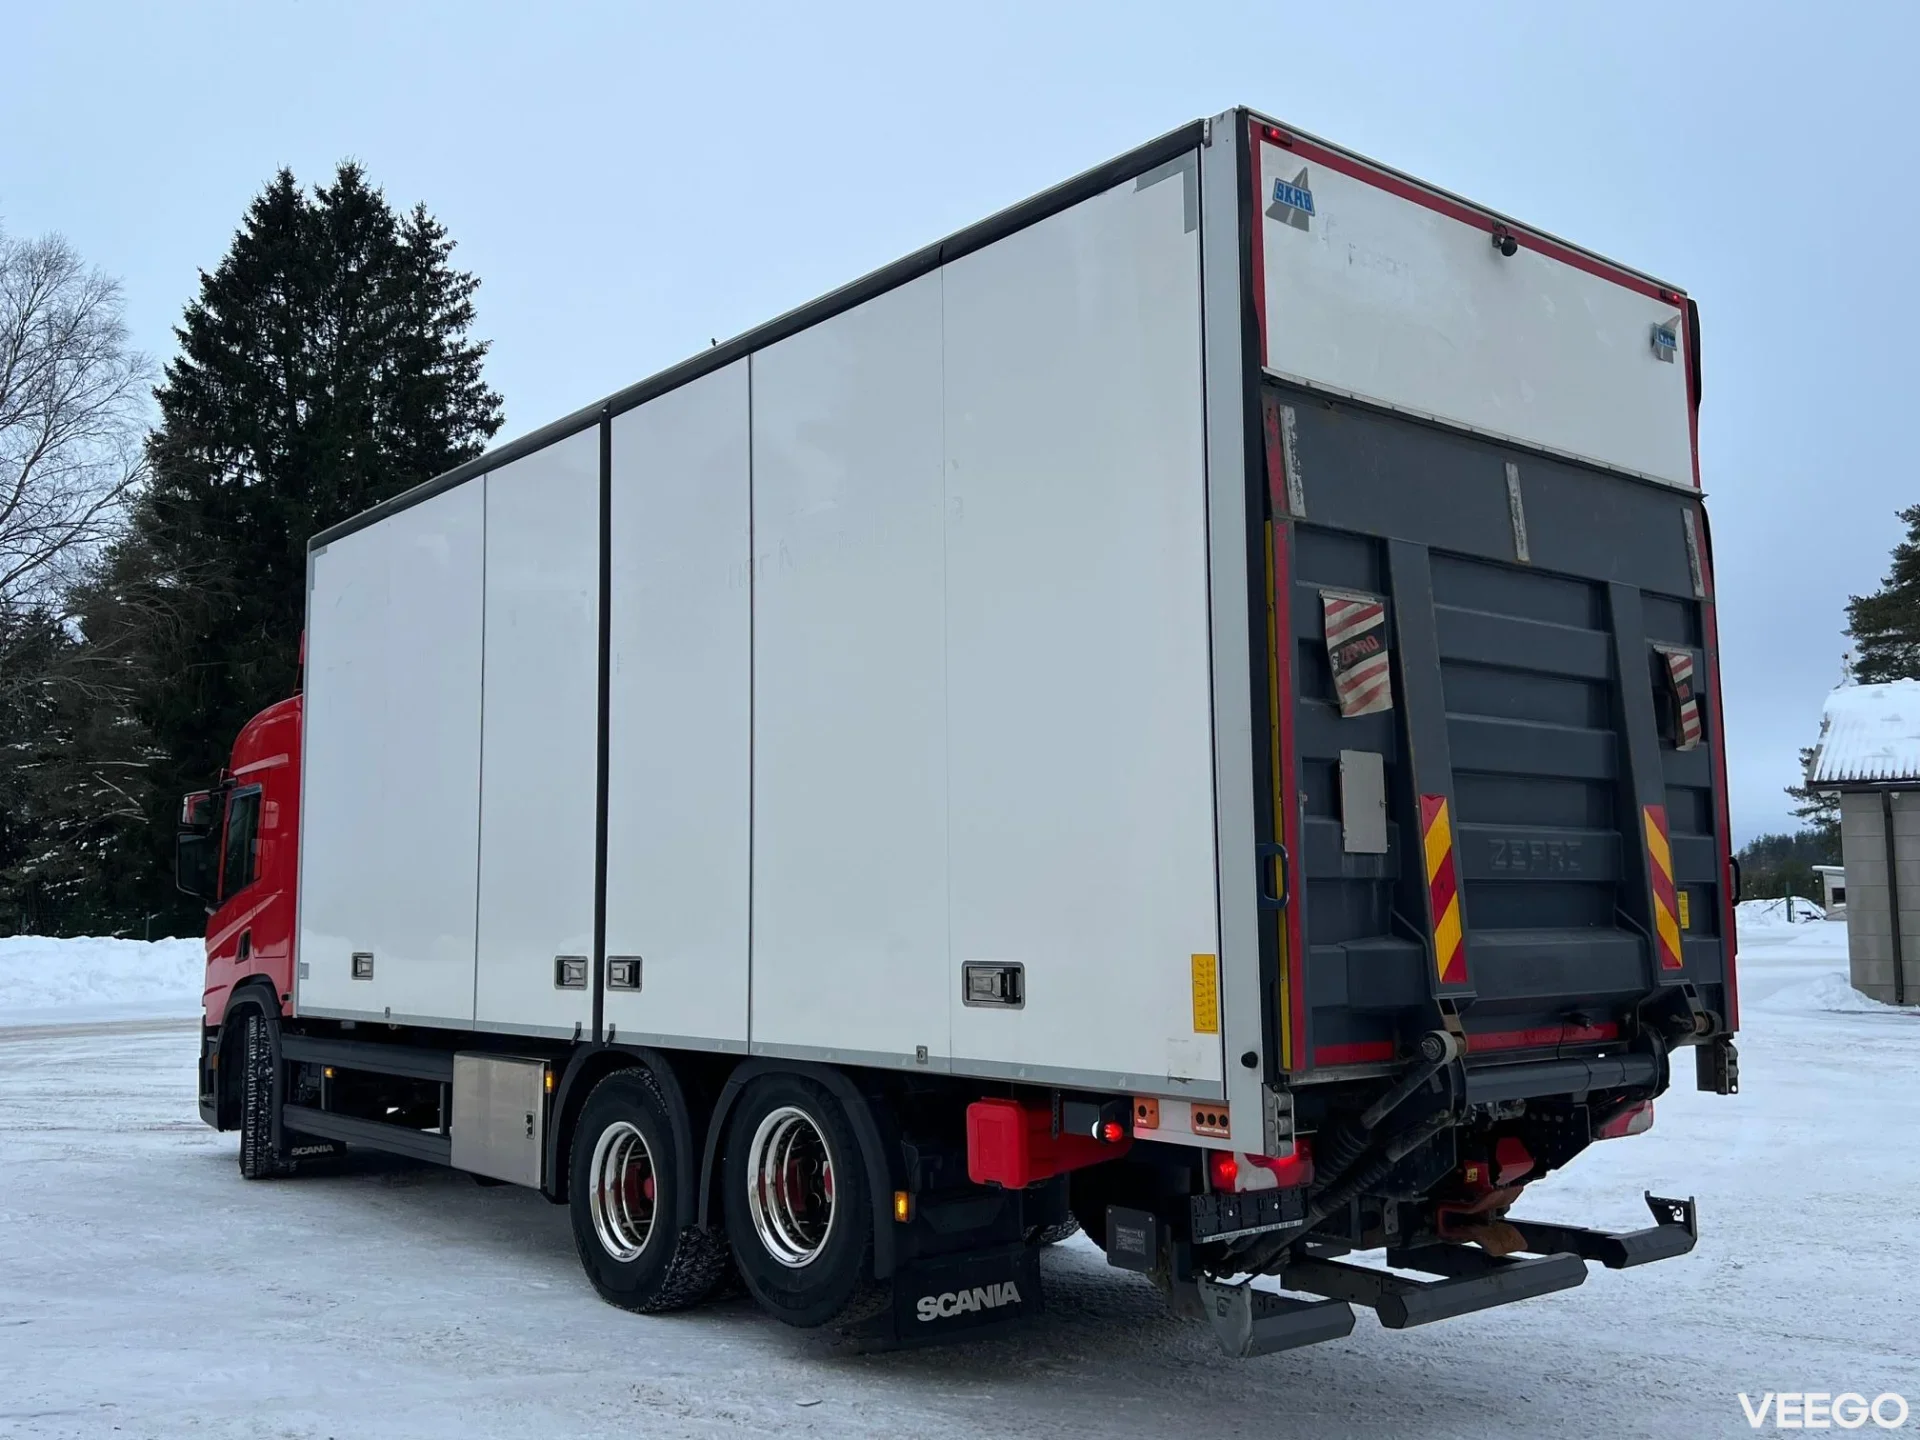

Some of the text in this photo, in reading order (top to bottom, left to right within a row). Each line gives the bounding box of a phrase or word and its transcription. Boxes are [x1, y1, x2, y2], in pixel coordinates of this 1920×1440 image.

[1275, 181, 1313, 212] SKAB
[291, 1144, 334, 1156] SCANIA
[917, 1281, 1021, 1321] SCANIA
